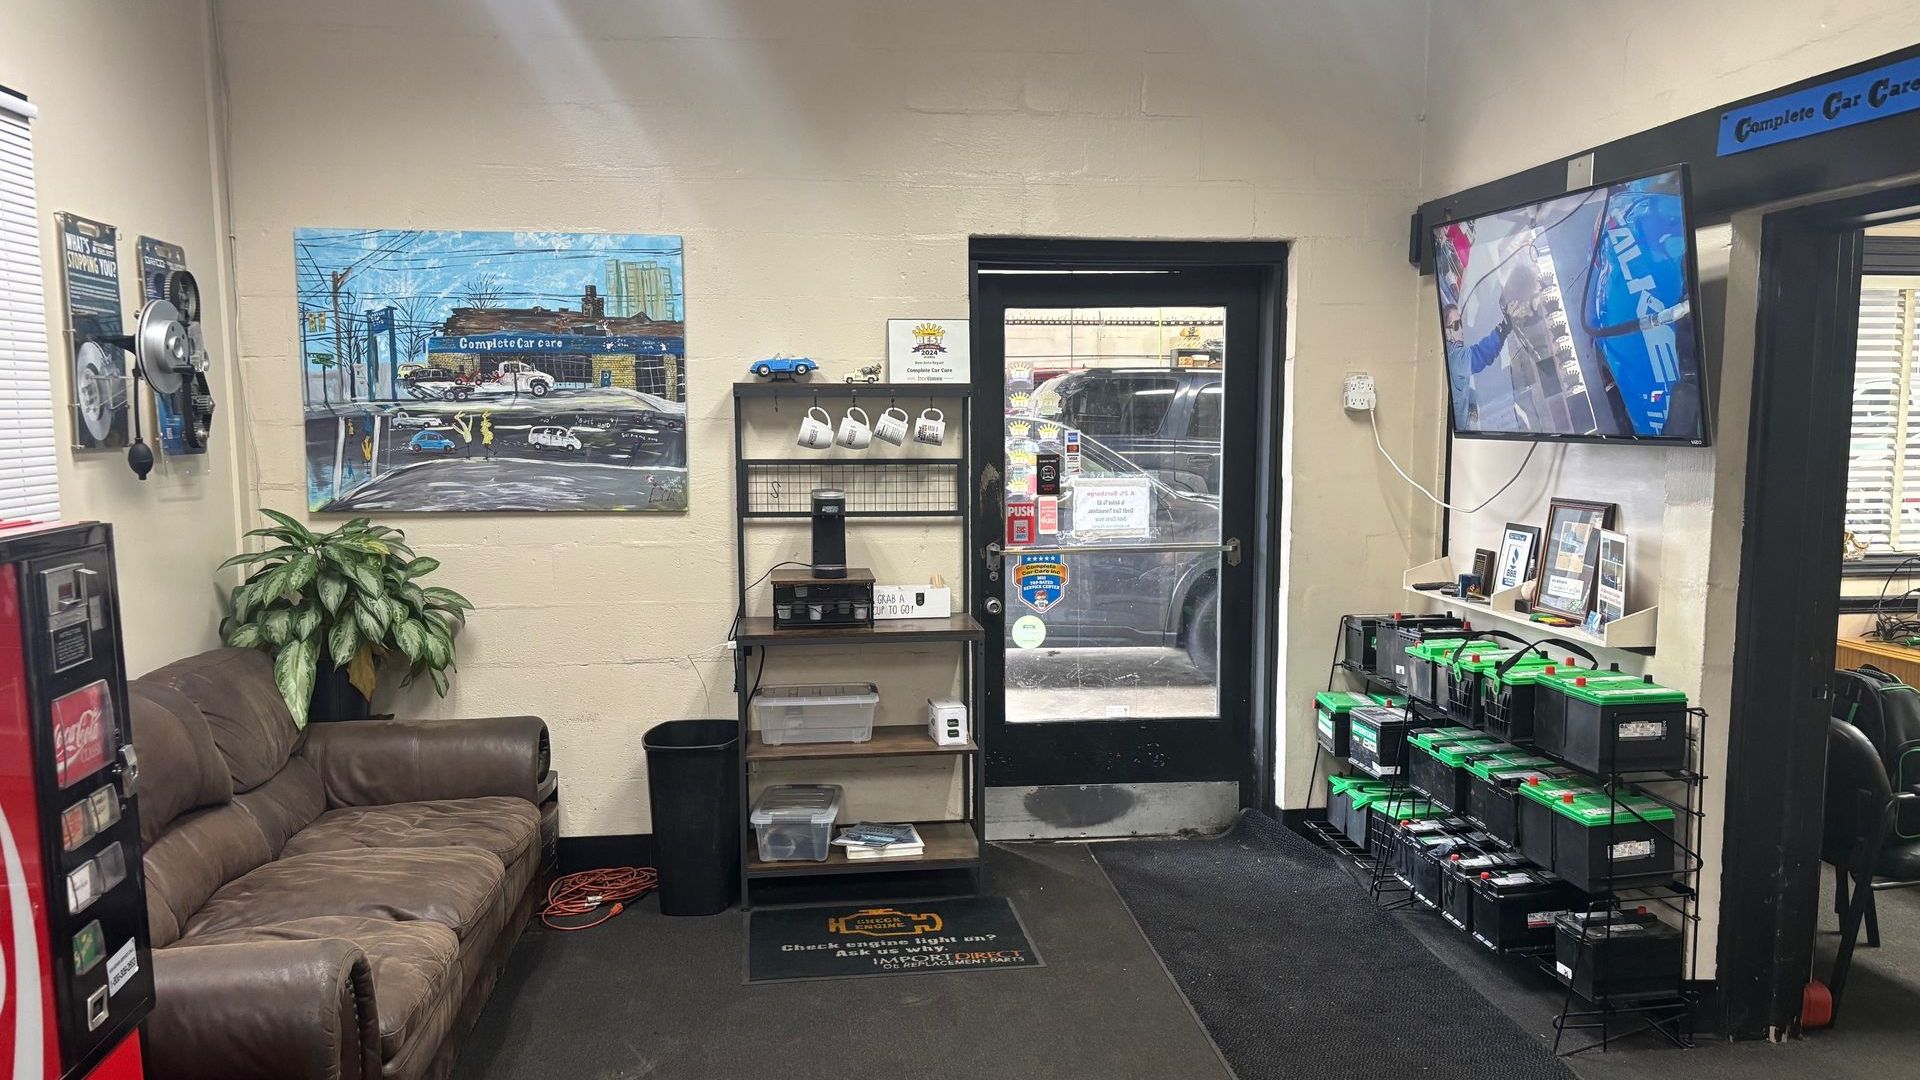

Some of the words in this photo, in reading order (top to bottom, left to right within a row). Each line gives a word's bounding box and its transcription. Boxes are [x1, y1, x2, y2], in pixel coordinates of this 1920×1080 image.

[1734, 106, 1815, 143] Complete
[1822, 90, 1861, 120] Car
[1867, 77, 1920, 108] Care
[66, 232, 91, 255] WHAT'S
[67, 250, 99, 274] STOPPING
[98, 258, 117, 278] YOU?
[459, 337, 516, 350] Complete
[517, 337, 535, 349] Car
[537, 339, 563, 348] care
[915, 335, 944, 344] BEST
[1007, 505, 1034, 517] PUSH
[1506, 568, 1517, 578] BBB
[877, 594, 896, 604] GRAB
[898, 594, 905, 603] A
[888, 605, 898, 615] TO
[900, 604, 914, 615] GO!
[855, 922, 905, 930] ENGINE
[781, 942, 840, 952] Check
[845, 939, 909, 949] engine
[915, 936, 958, 945] light
[835, 948, 871, 957] Ask
[905, 945, 949, 953] why.
[903, 958, 987, 968] REPLACEMENT
